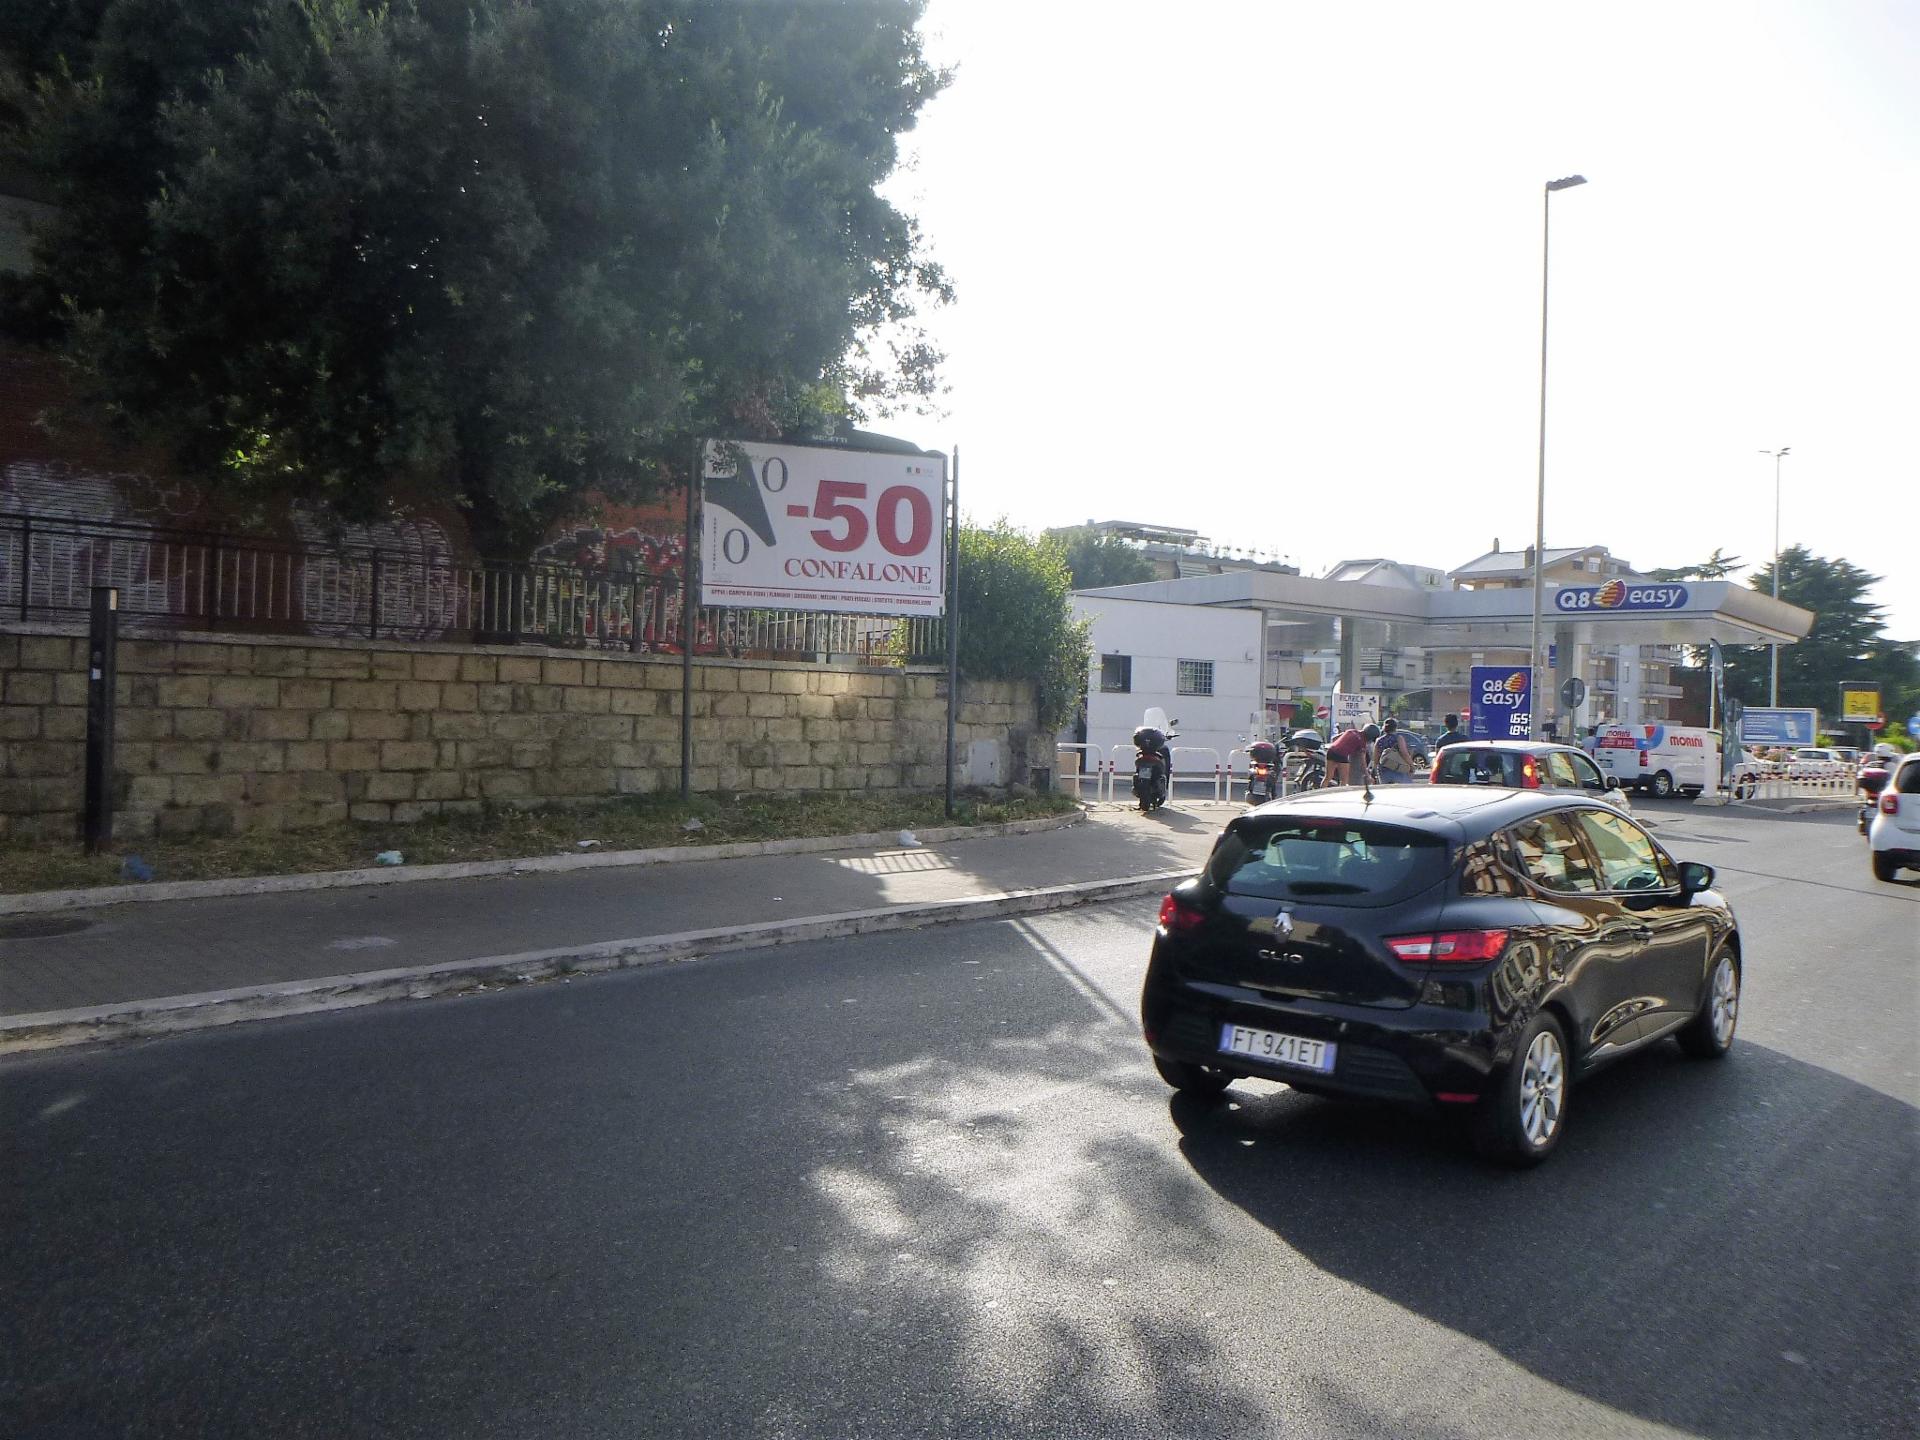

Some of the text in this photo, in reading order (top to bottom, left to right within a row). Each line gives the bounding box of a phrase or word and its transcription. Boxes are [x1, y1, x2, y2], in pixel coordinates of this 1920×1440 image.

[787, 480, 933, 557] -50
[784, 558, 932, 584] CONFALONE
[1559, 588, 1682, 609] Q8 easy
[1482, 679, 1504, 692] Q8
[1482, 692, 1526, 710] easy
[1669, 735, 1704, 748] MORINI
[1259, 949, 1303, 963] CLIO
[1232, 1027, 1257, 1053] FT
